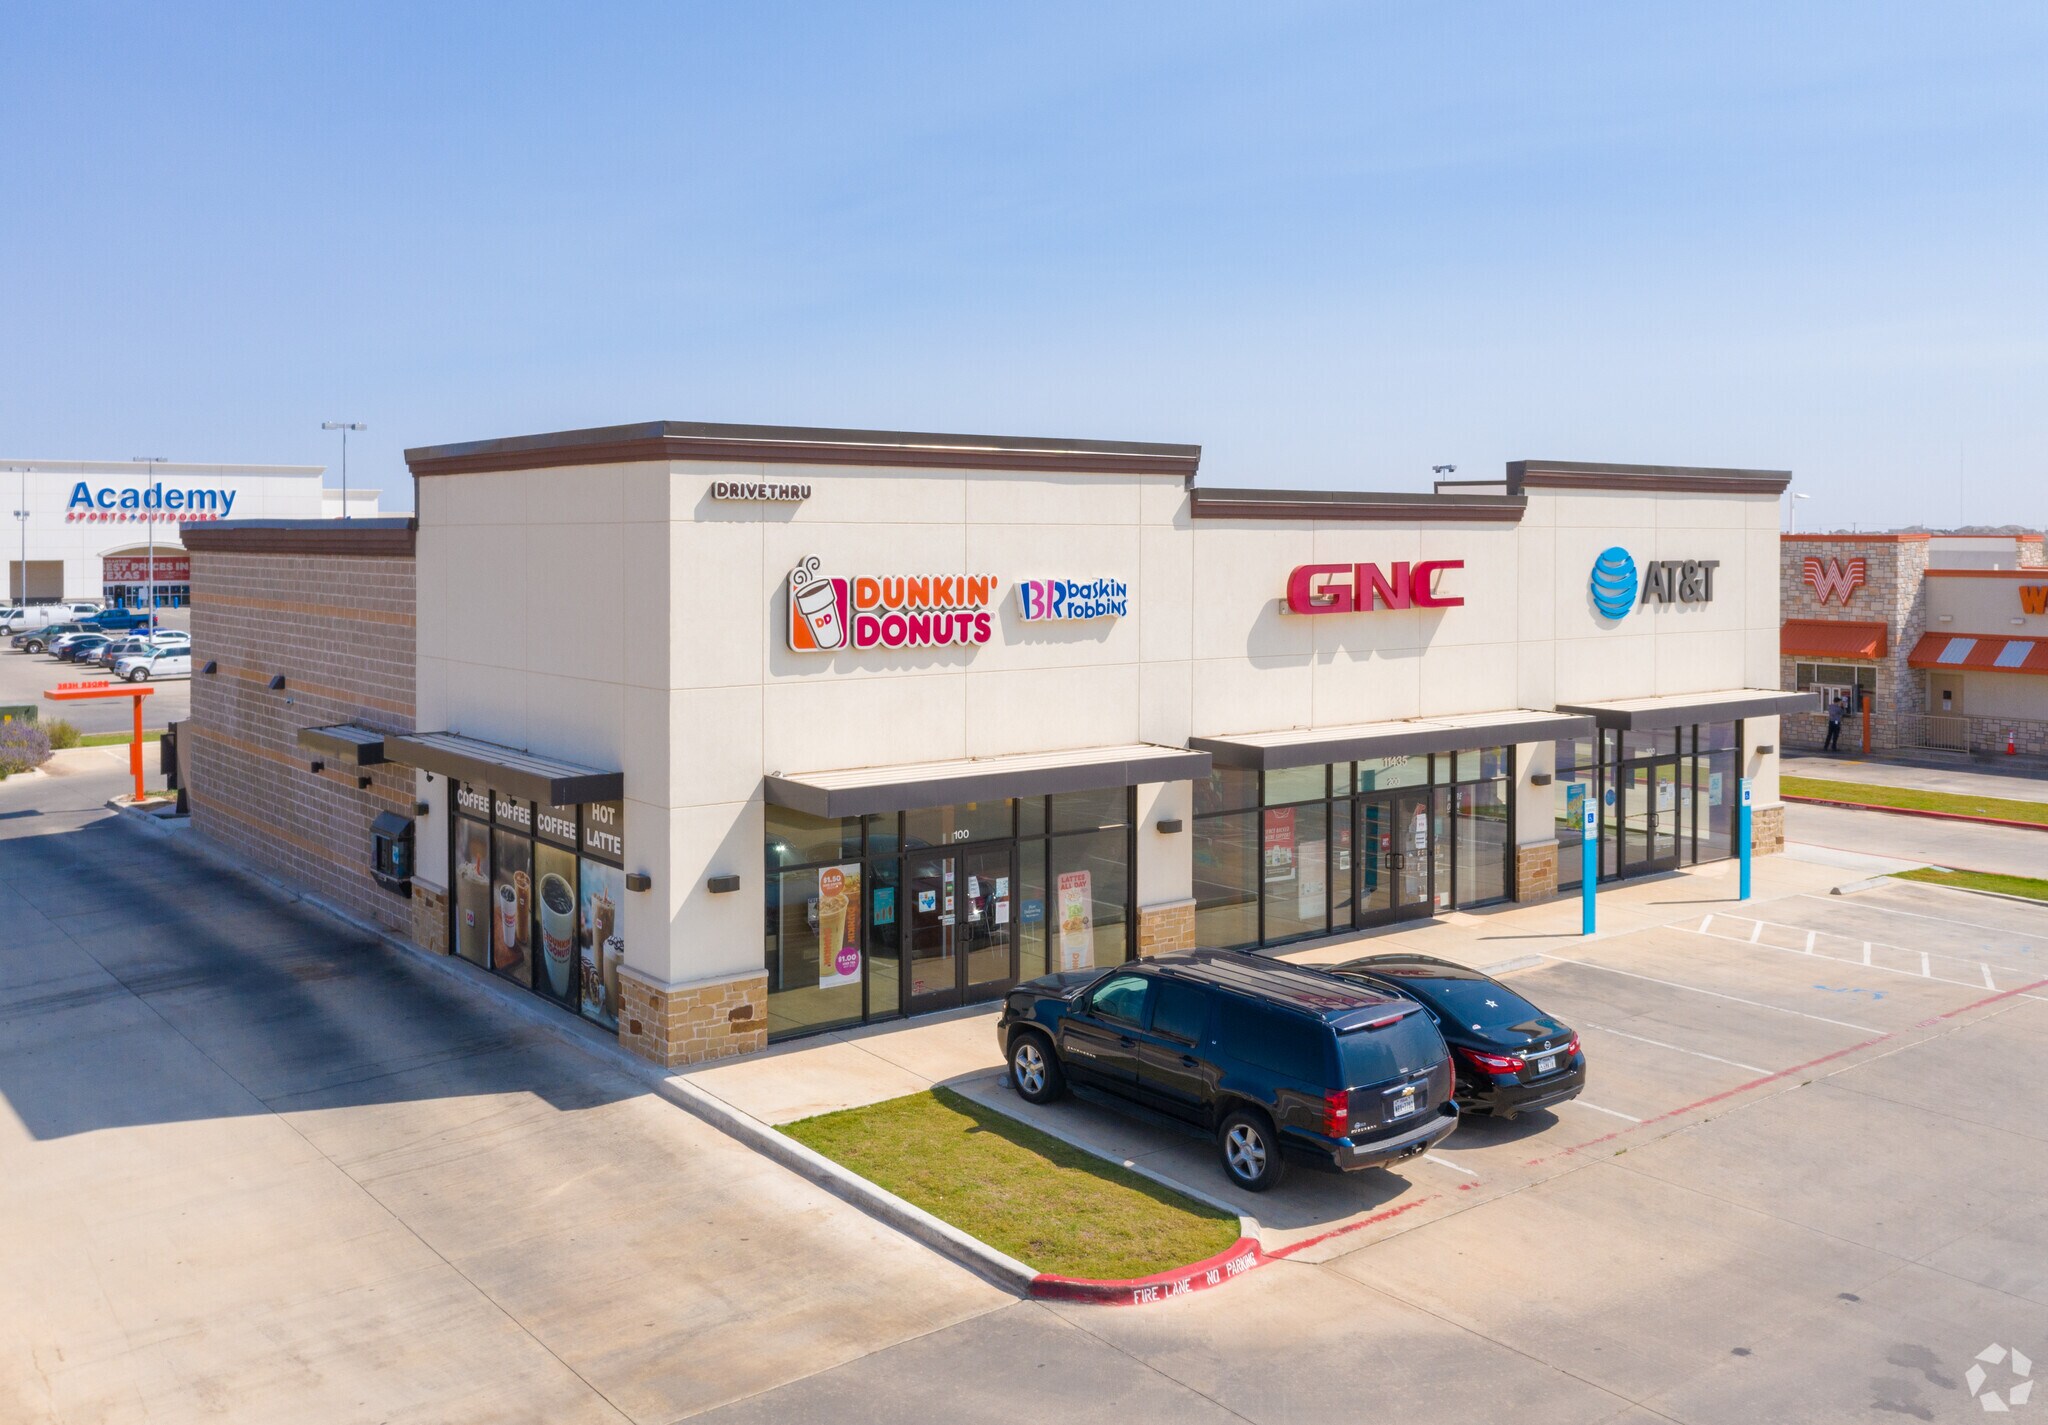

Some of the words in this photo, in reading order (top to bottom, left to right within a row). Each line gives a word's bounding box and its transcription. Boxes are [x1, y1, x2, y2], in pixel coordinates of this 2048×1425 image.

[69, 481, 237, 517] Academy
[103, 563, 130, 571] EST
[856, 575, 998, 609] DUNKIN'
[1287, 559, 1465, 615] GNC
[1641, 559, 1720, 604] AT&T
[1020, 579, 1067, 619] BR
[815, 613, 832, 628] DD
[856, 612, 992, 647] DONUTS
[457, 789, 490, 814] COFFEE
[495, 800, 531, 825] COFFEE
[592, 802, 615, 825] HOT
[537, 813, 576, 840] COFFEE
[953, 829, 970, 840] 100
[586, 828, 622, 855] LATTE
[1061, 873, 1086, 883] LATTES
[838, 953, 857, 963] $1.00
[1133, 1286, 1160, 1305] FIRE
[1165, 1278, 1192, 1298] LANE
[1206, 1269, 1221, 1285] NO
[1225, 1251, 1257, 1277] PARKING
